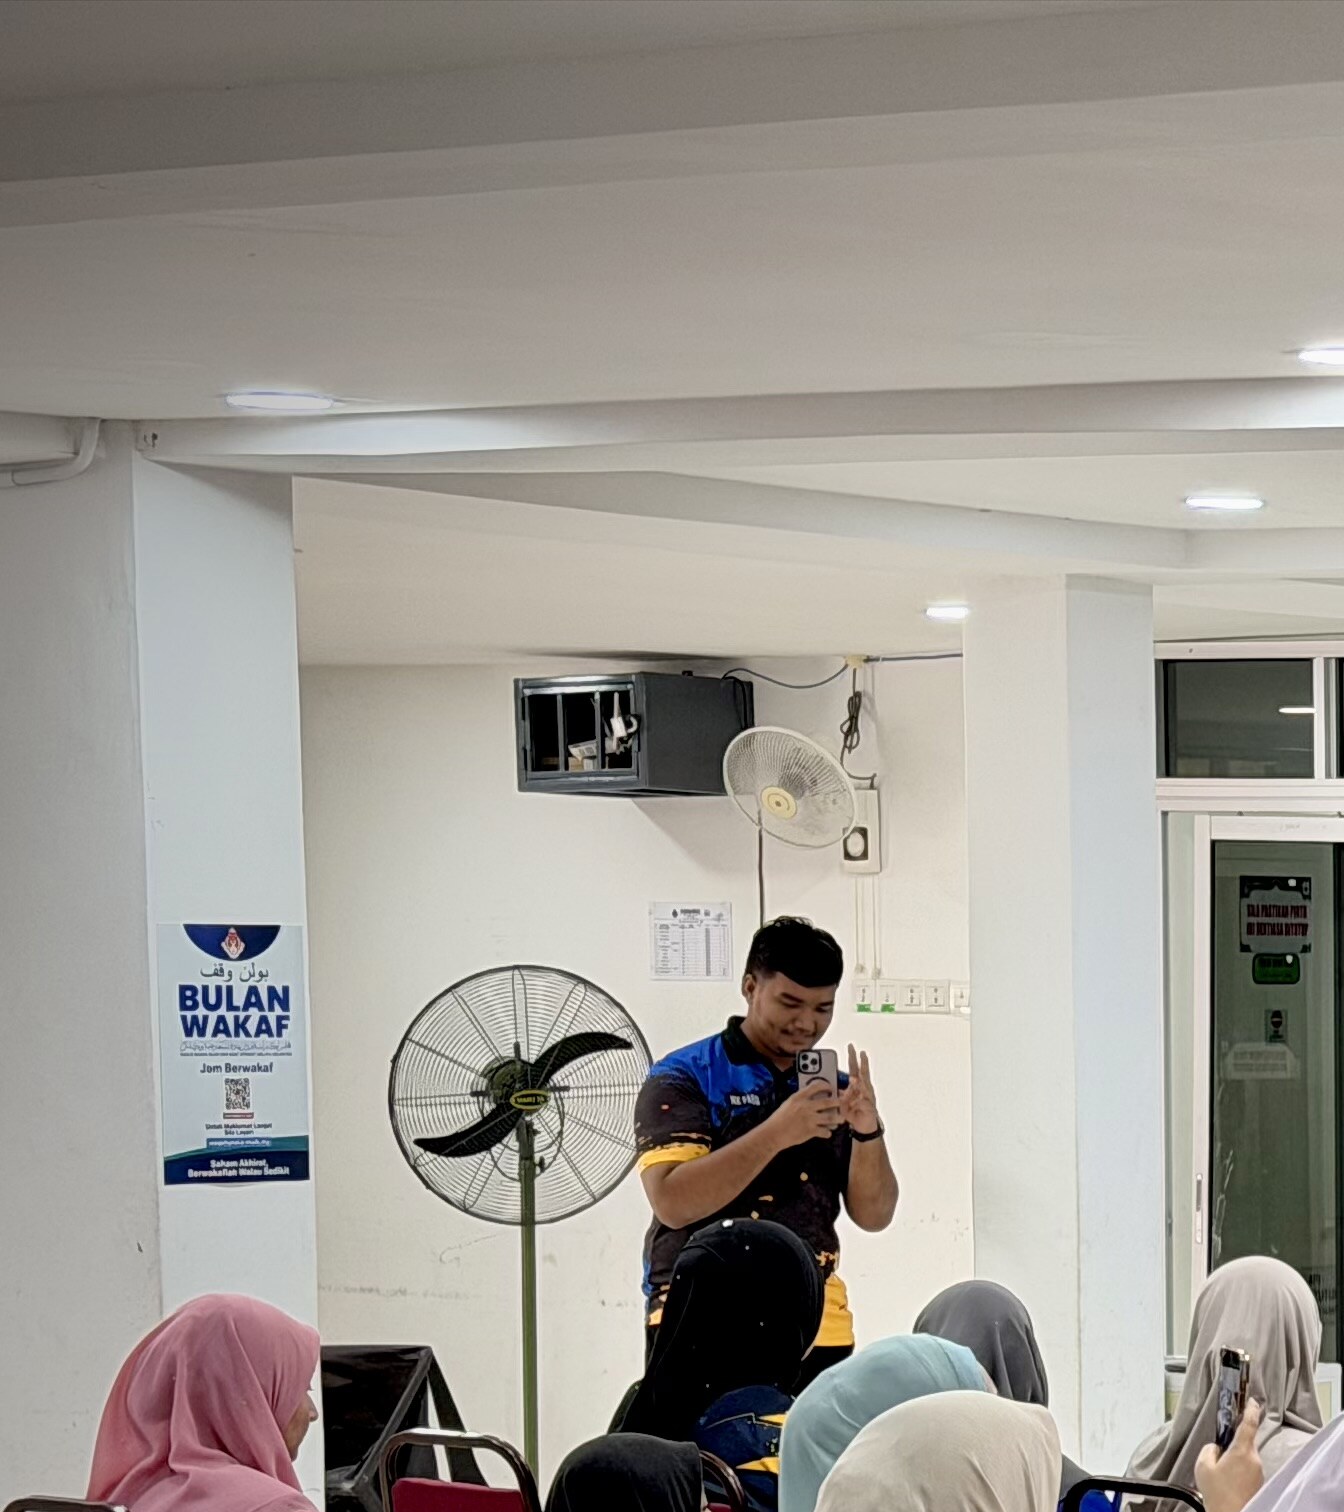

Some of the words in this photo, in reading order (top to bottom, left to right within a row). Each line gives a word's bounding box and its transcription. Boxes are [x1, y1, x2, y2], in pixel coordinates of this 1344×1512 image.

[178, 984, 290, 1012] BULAN
[180, 1014, 290, 1038] WAKAF
[200, 1063, 222, 1073] Jom
[224, 1061, 274, 1073] Berwakaf
[210, 1160, 239, 1169] Saham
